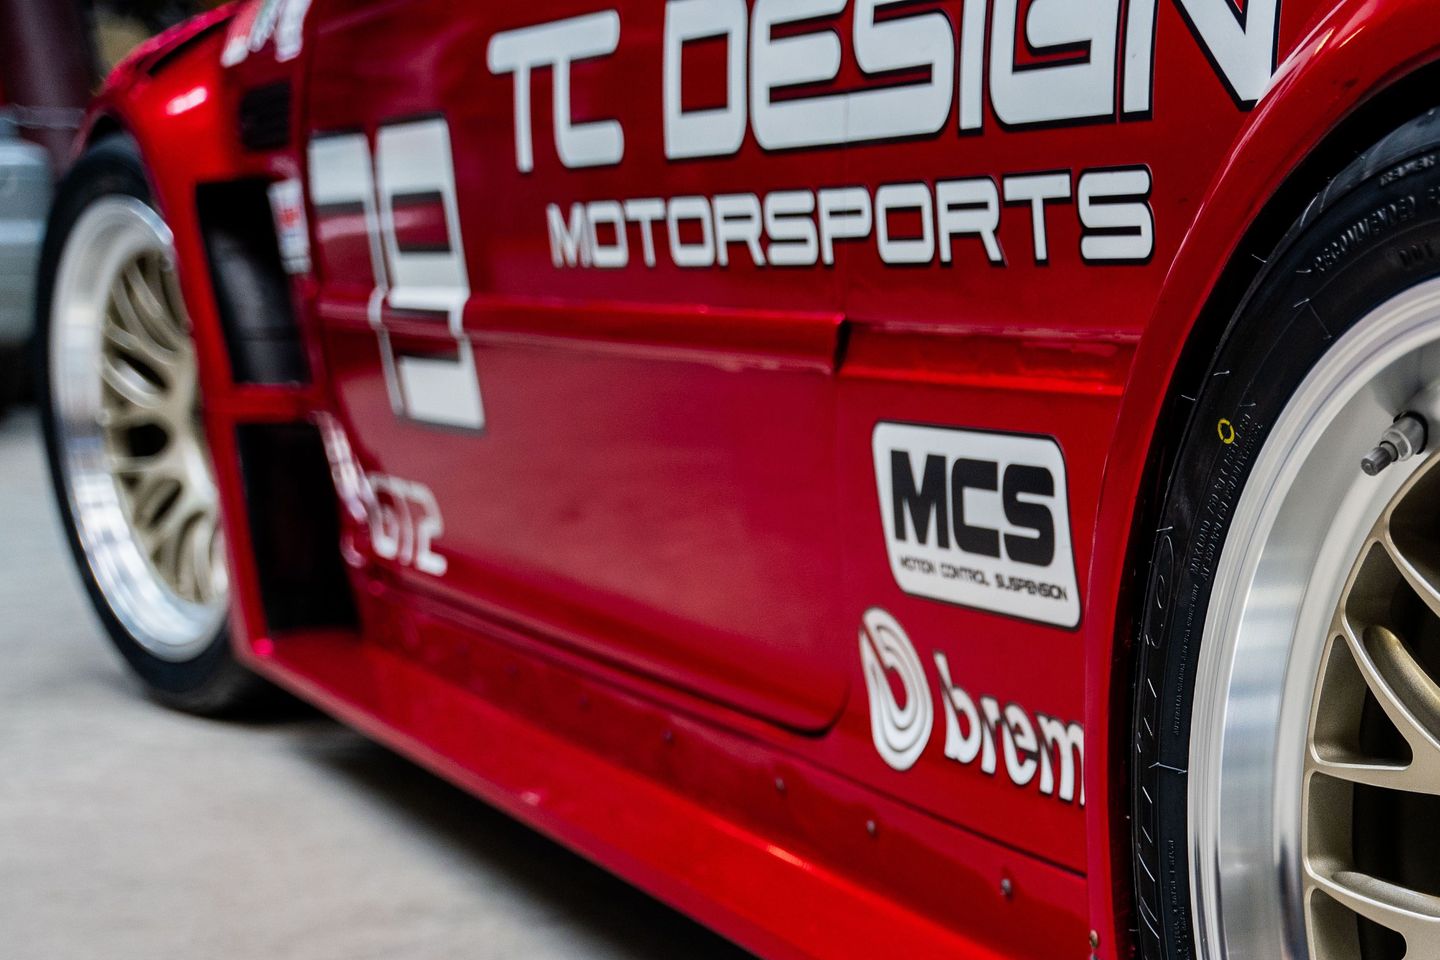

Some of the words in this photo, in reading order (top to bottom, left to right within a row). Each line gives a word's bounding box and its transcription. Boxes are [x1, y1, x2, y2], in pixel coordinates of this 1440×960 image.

[487, 10, 624, 172] TC
[664, 0, 1284, 161] DESIGN
[546, 163, 1152, 269] MOTORSPORTS
[889, 448, 1056, 568] MCS
[899, 555, 937, 574] MOTION
[940, 562, 990, 587] CONTROL
[994, 572, 1069, 602] SUSPENSION
[933, 648, 1086, 807] brem
